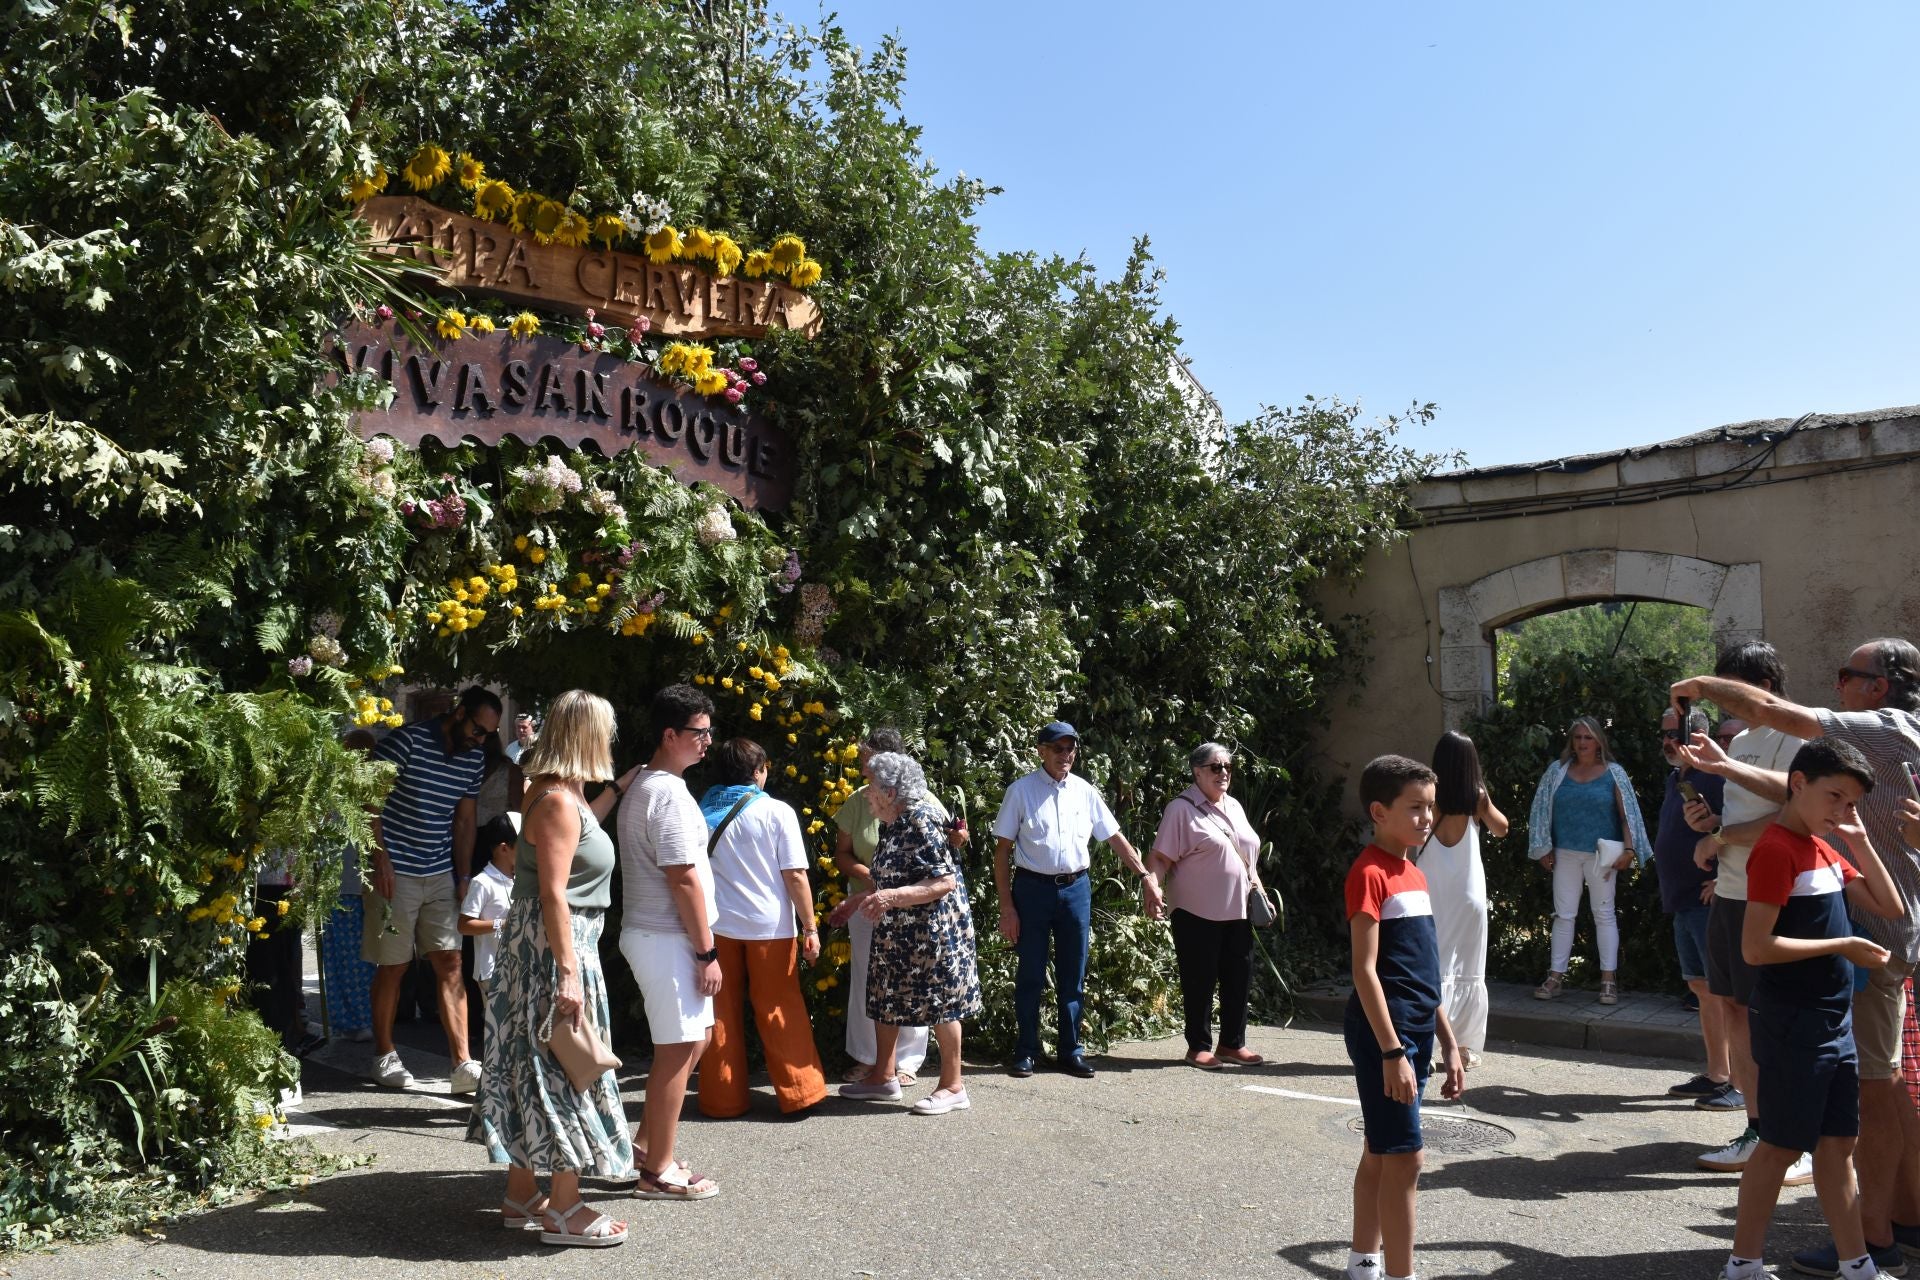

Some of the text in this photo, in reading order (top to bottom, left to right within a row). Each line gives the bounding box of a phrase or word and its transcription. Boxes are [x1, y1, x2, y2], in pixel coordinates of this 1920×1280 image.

[576, 254, 790, 329] CERVERA
[501, 359, 613, 421] SAN
[622, 385, 777, 480] ROQUE
